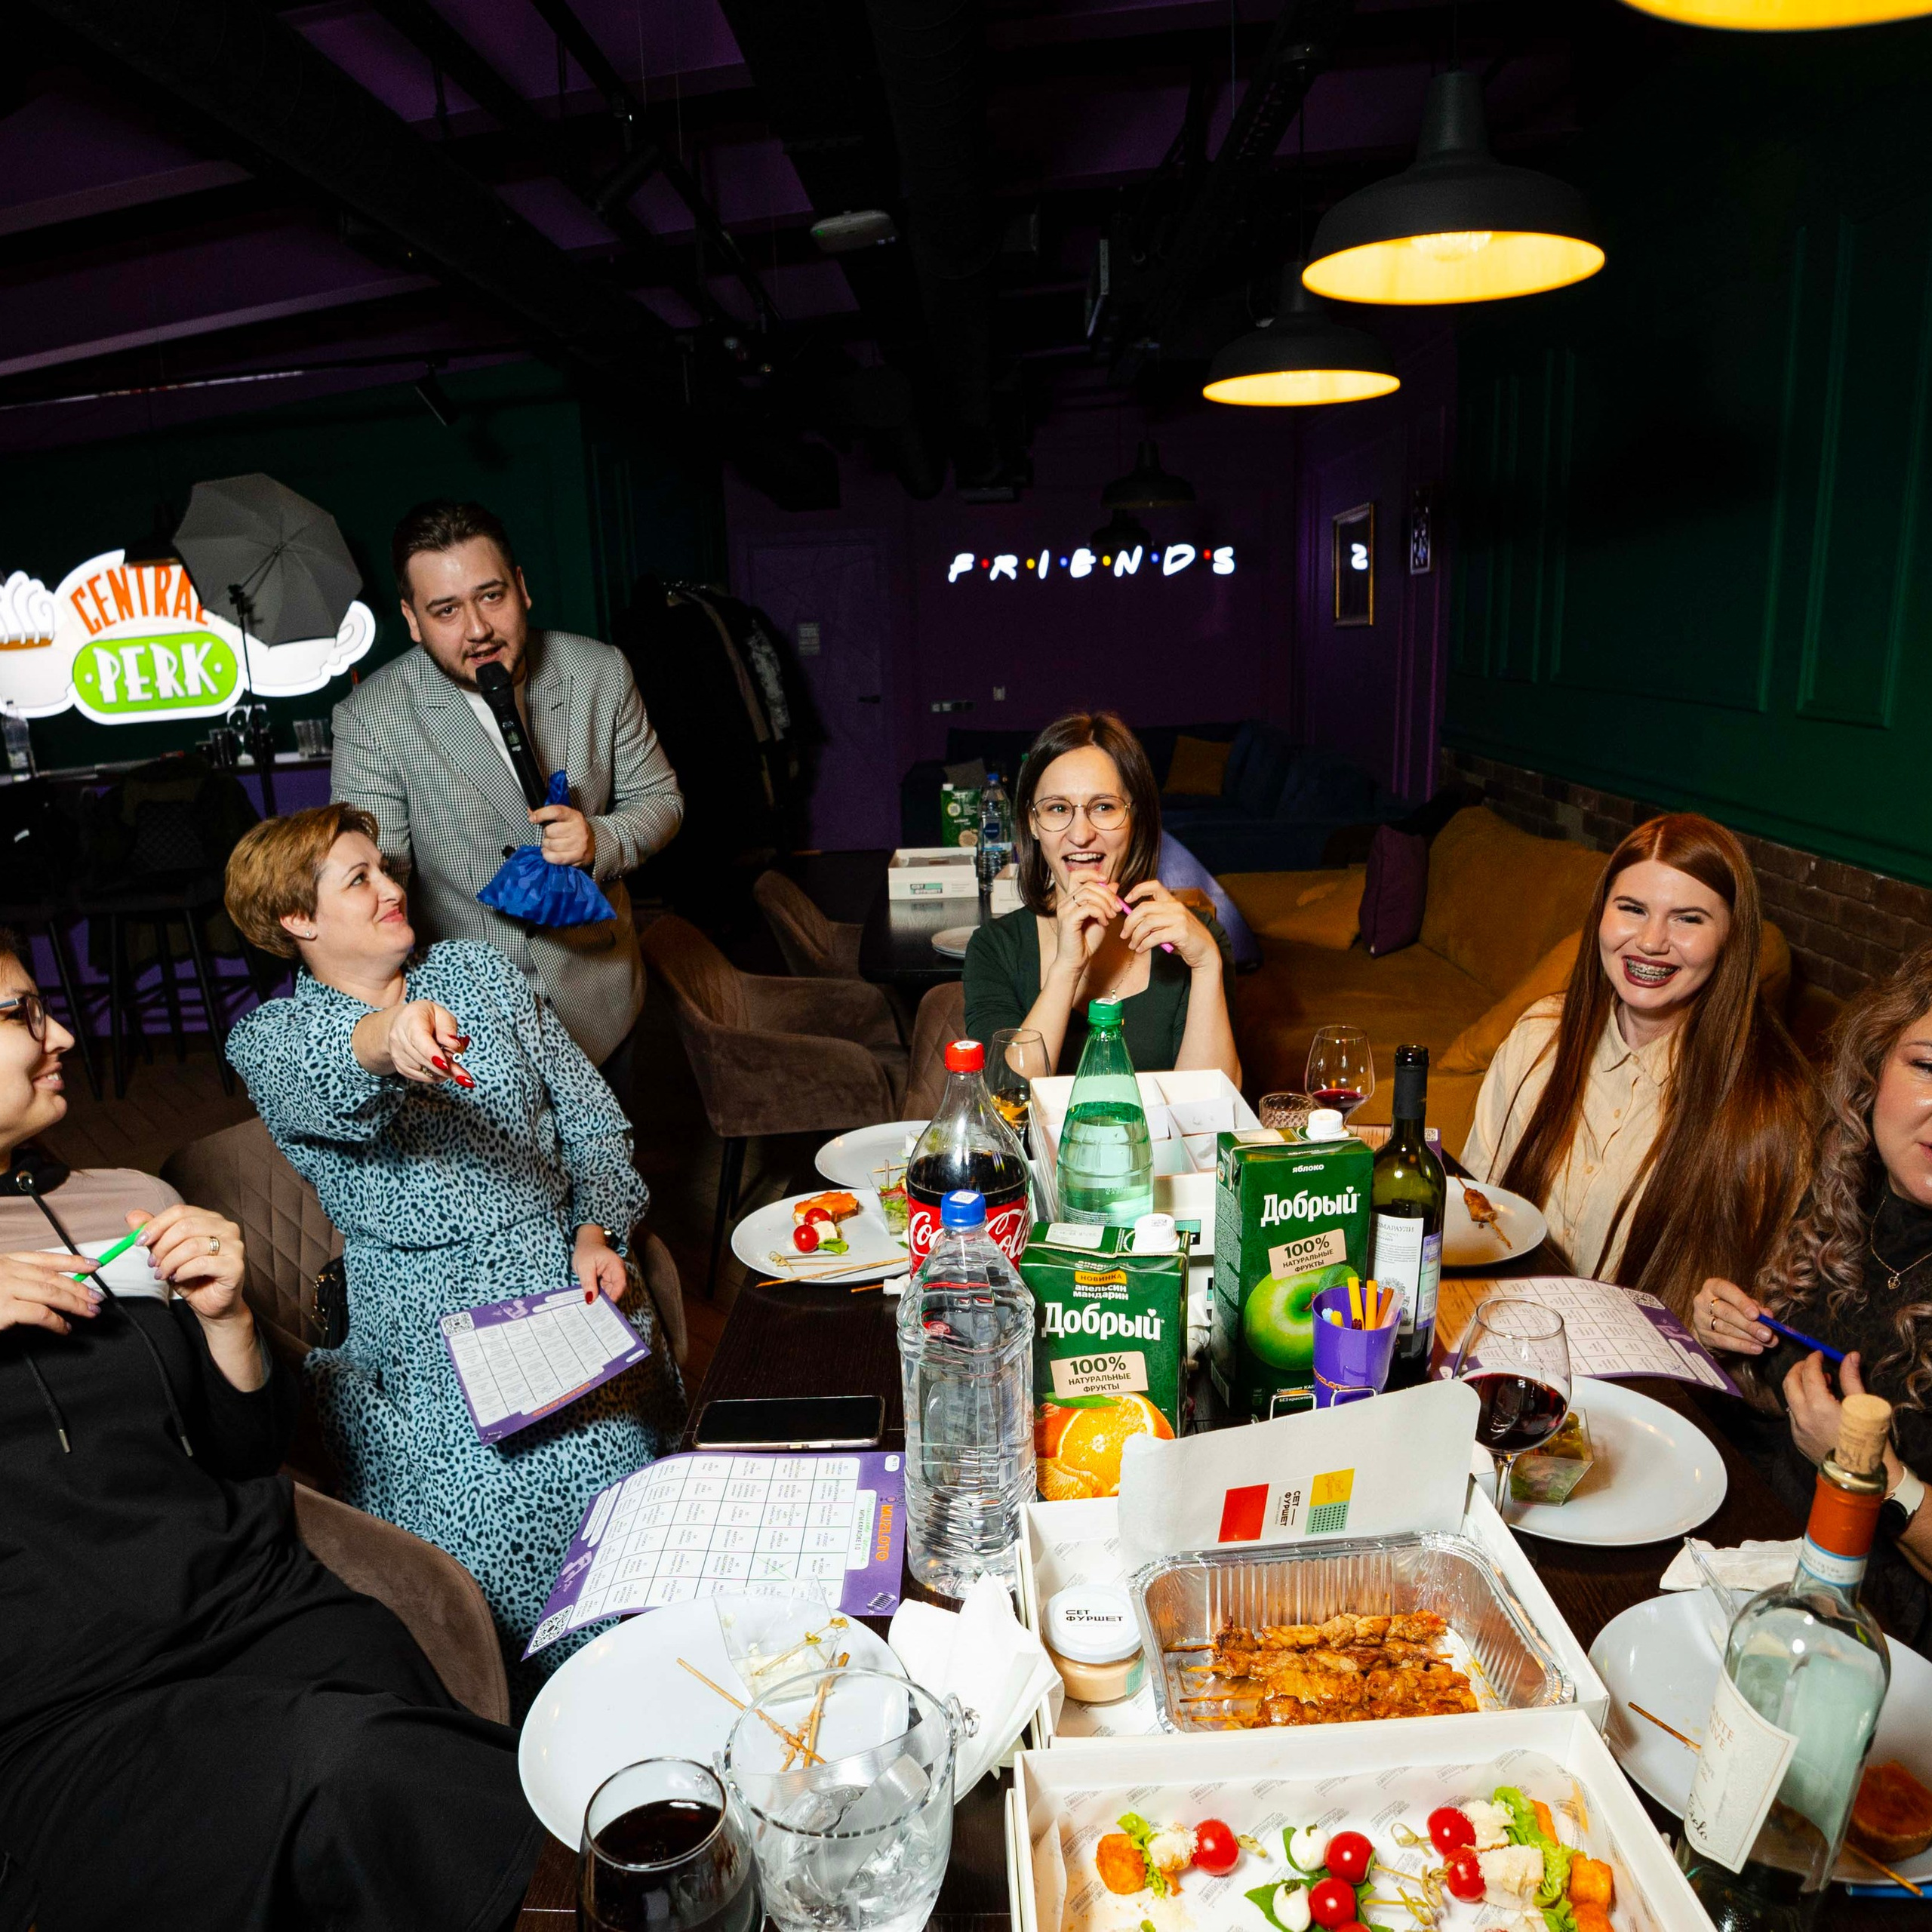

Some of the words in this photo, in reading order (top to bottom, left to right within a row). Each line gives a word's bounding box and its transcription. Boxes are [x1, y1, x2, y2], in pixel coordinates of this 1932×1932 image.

[92, 641, 220, 704] PERK
[1292, 1164, 1324, 1174] яблоко
[1260, 1186, 1358, 1228] Добрый
[1284, 1235, 1331, 1260] 100%
[1282, 1248, 1334, 1269] НАТУРАЛЬНЫЕ
[1294, 1260, 1324, 1273] ФРУКТЫ
[1080, 1273, 1123, 1281] НОВИНКА
[1072, 1291, 1129, 1300] мандарин
[1075, 1284, 1128, 1293] апельсин
[1041, 1302, 1161, 1341] Добрый
[1069, 1355, 1127, 1375] 100%
[1068, 1372, 1131, 1386] НАТУРАЛЬНЫЕ
[1083, 1383, 1120, 1392] ФРУКТЫ
[1292, 1491, 1301, 1506] СЕТ
[1280, 1491, 1292, 1526] ФУРШЕТ
[875, 1504, 894, 1561] MUZLOTO
